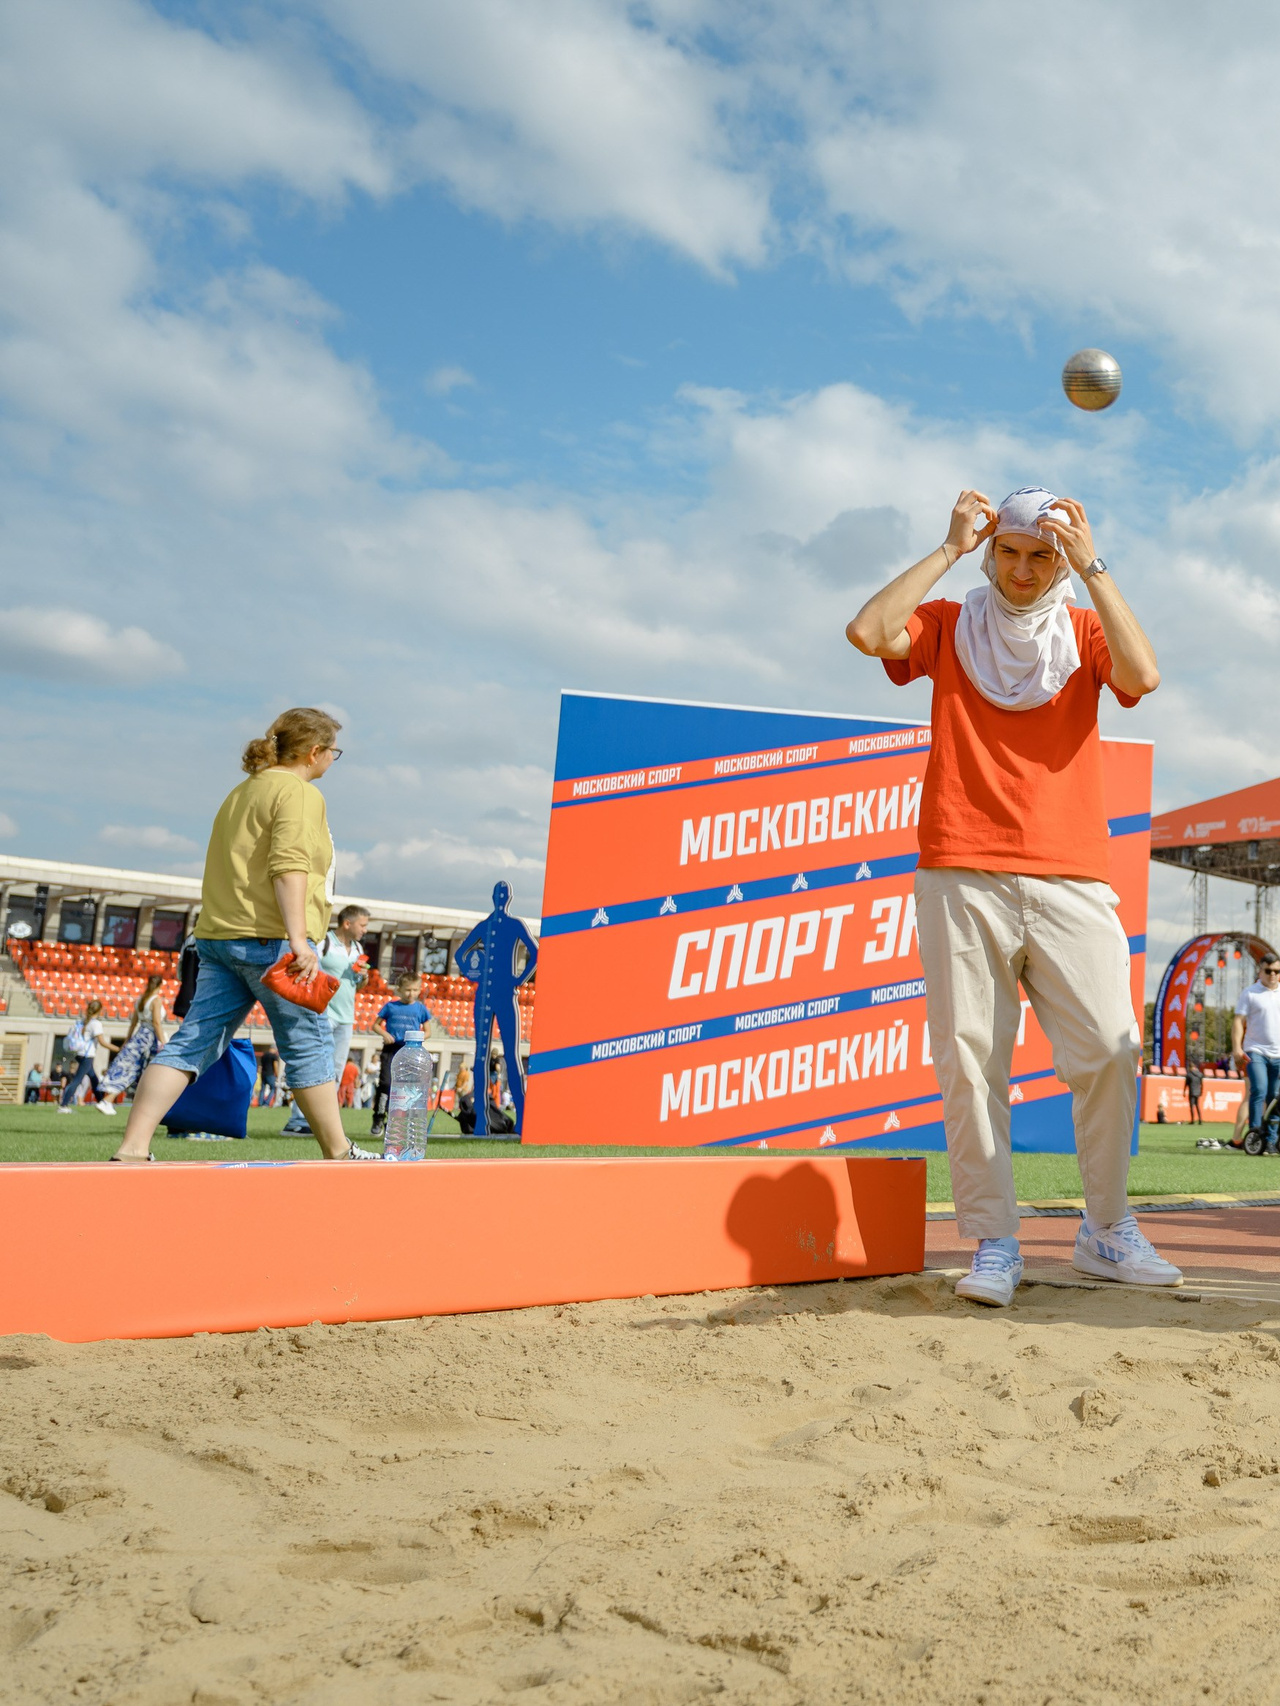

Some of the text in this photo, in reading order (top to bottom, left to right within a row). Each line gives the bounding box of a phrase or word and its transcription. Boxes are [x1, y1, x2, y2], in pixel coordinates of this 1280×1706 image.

[849, 731, 914, 754] МОСКОВСКИЙ
[714, 746, 818, 775] МОСКОВСКИЙ СПОРТ
[573, 766, 682, 796] МОСКОВСКИЙ СПОРТ
[679, 777, 923, 866] МОСКОВСКИЙ
[667, 903, 855, 1000] СПОРТ
[871, 980, 927, 1004] МОСКОВСК
[735, 997, 840, 1032] МОСКОВСКИЙ СПОРТ
[592, 1024, 702, 1061] МОСКОВСКИЙ СПОРТ
[659, 1019, 909, 1122] МОСКОВСКИЙ
